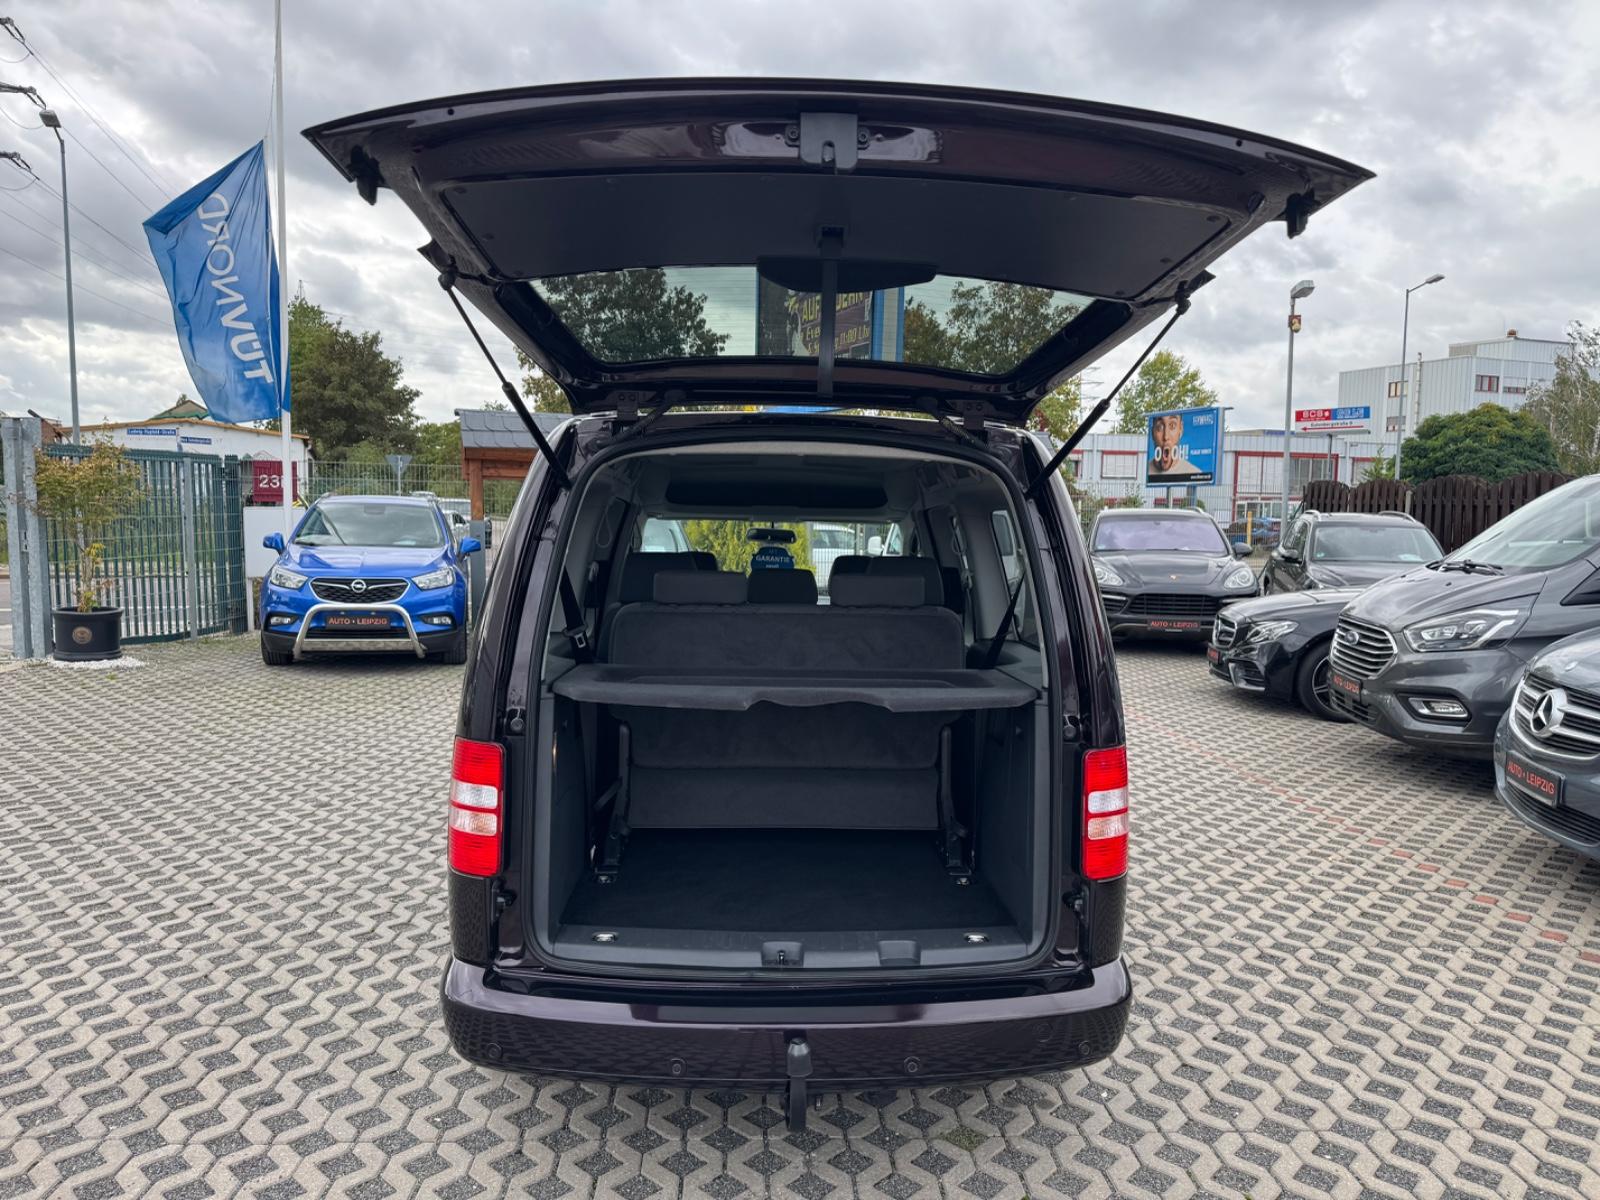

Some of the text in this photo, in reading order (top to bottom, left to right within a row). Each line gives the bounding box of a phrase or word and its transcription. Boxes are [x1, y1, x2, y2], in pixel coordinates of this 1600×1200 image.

[259, 474, 285, 489] 23
[328, 617, 388, 625] AUTO LEIPZIG
[1508, 761, 1555, 794] AUTO LEIPZIG
